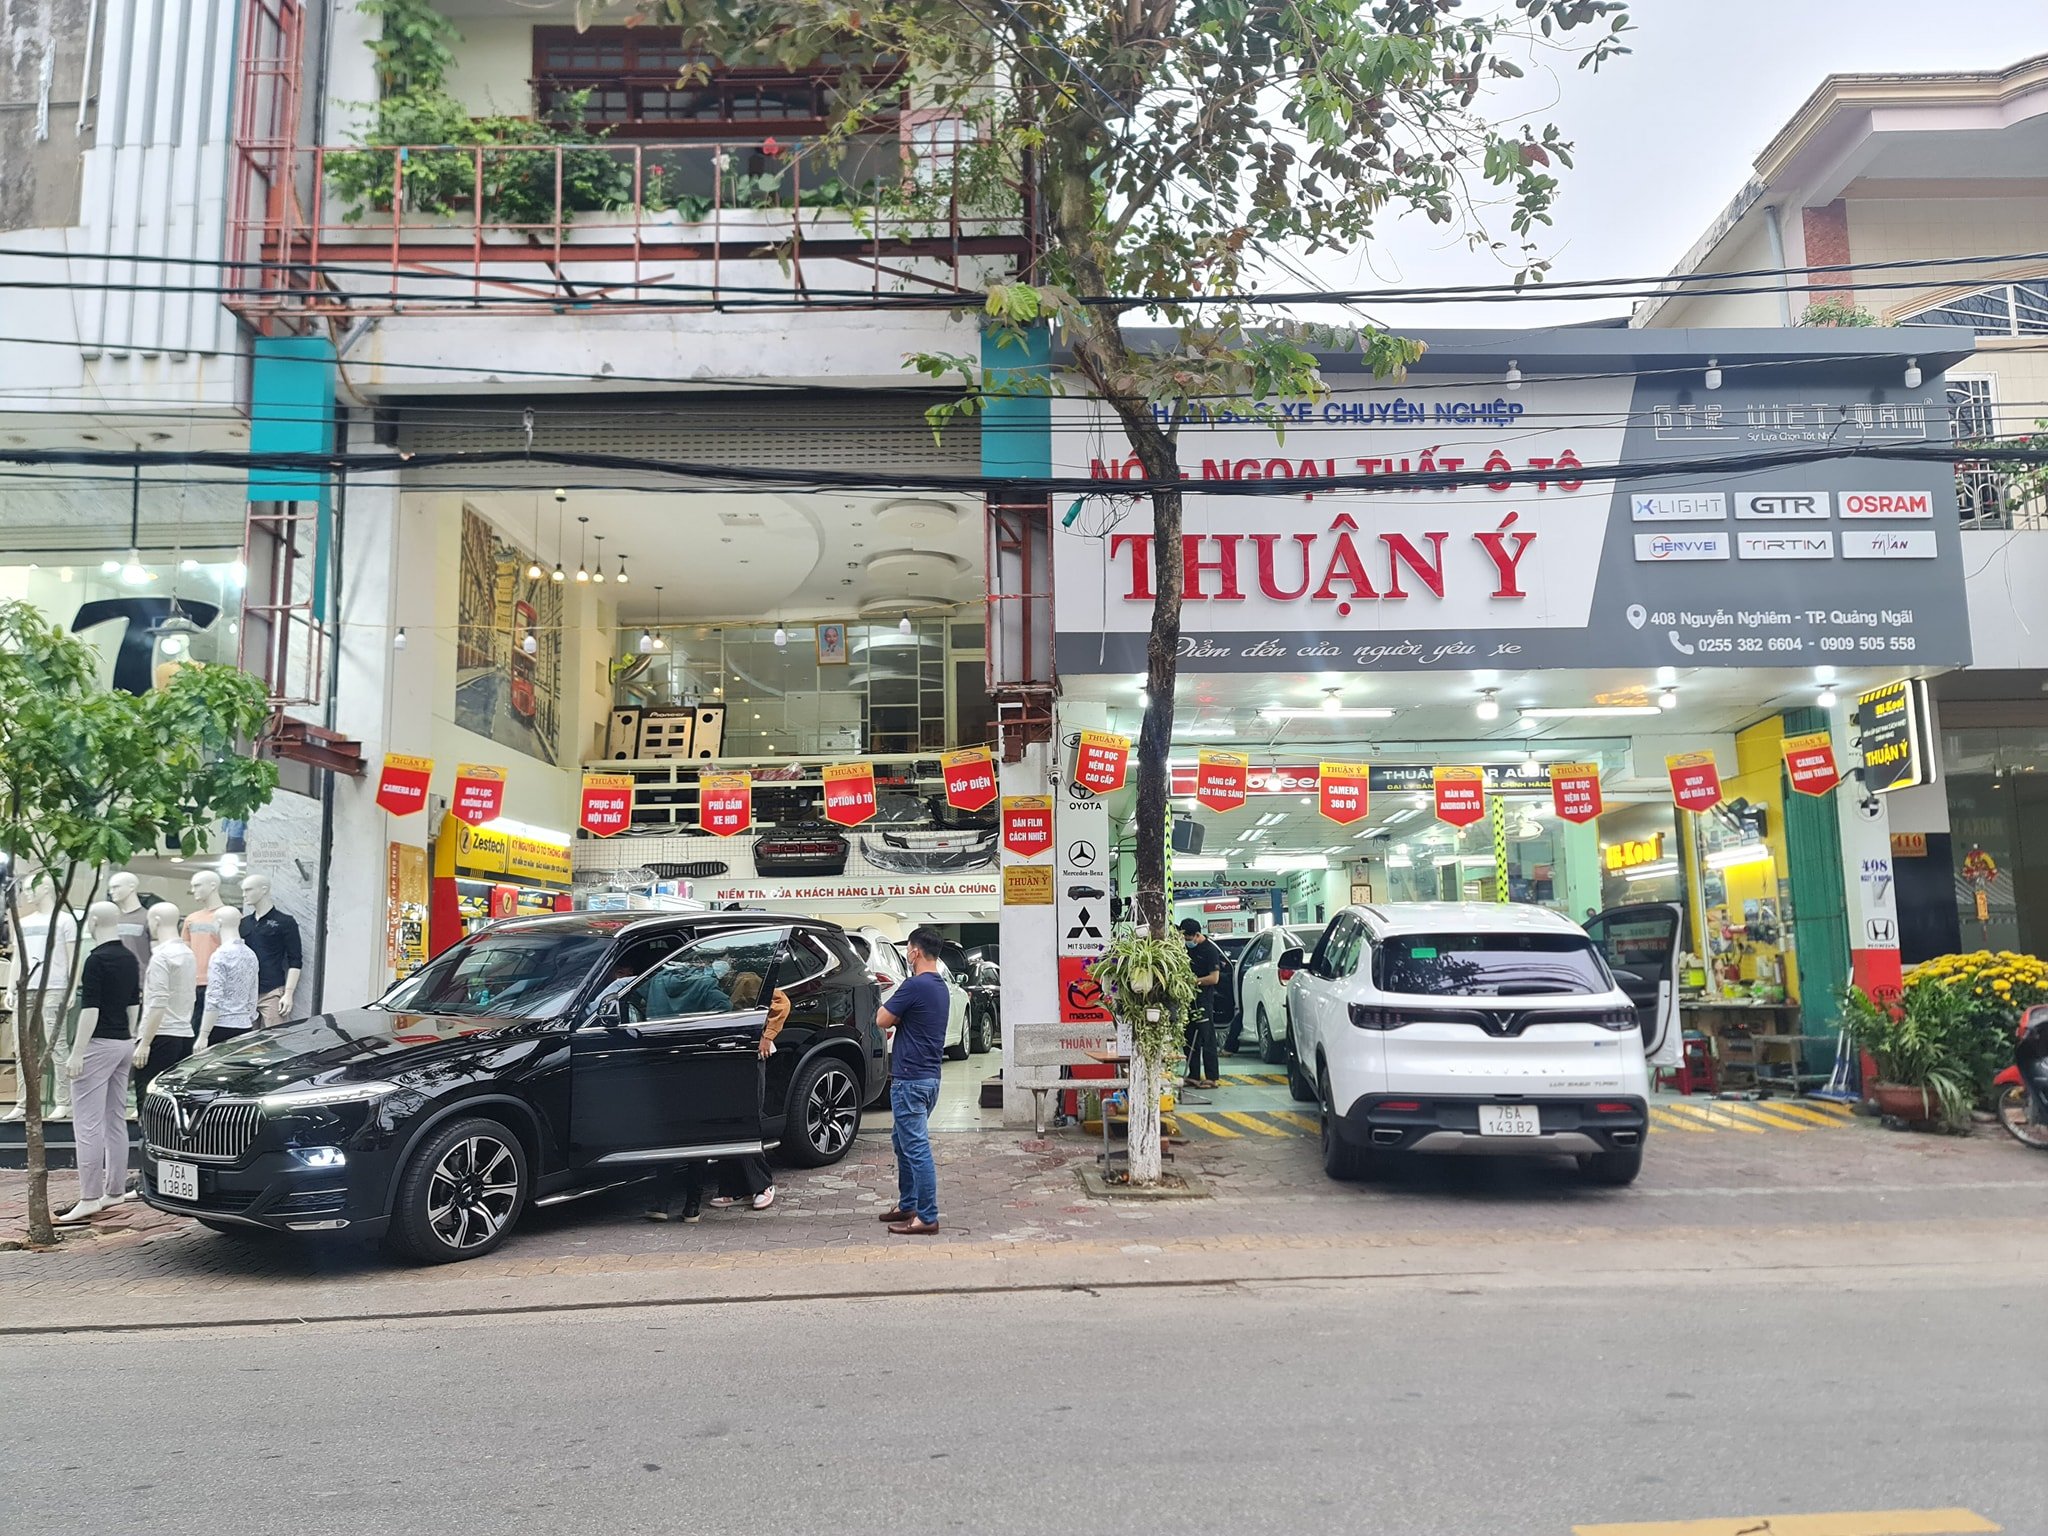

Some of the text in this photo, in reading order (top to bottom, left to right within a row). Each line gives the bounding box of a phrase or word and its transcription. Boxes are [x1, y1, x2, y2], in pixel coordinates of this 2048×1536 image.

[1281, 397, 1524, 428] XE CHUYÊN NGHIỆP
[1802, 431, 1815, 440] Tốt
[1528, 449, 1584, 492] TÔ
[1750, 496, 1817, 514] GTR
[1846, 495, 1928, 513] OSRAM
[1746, 539, 1827, 551] TIRTIM
[1110, 511, 1538, 618] THUẬN Ý
[1651, 608, 1913, 629] 408 Nguyễn Nghiêm TP. Quảng Ngãi
[1241, 638, 1288, 658] đến
[1297, 640, 1342, 657] của
[1353, 639, 1422, 664] người
[1419, 640, 1477, 664] yêu
[1487, 643, 1523, 658] xe
[1698, 637, 1916, 652] 0255 382 6604 0909 505 558
[1088, 748, 1119, 761] MAY BỌC
[1865, 738, 1908, 768] THUẬN Ý
[1088, 760, 1115, 773] NỆM DA
[950, 776, 991, 794] CỐP ĐIỆN
[1085, 772, 1115, 785] CAO CẤP
[1207, 776, 1224, 786] NÂNG
[1224, 776, 1238, 787] CẤP
[1328, 785, 1360, 796] CAMERA
[1576, 781, 1591, 790] BỌC
[1706, 786, 1716, 796] XE
[828, 791, 873, 808] OPTION Ô TÔ
[1199, 787, 1244, 799] ĐÈN TĂNG SÁNG
[589, 799, 609, 811] PHỤC
[708, 799, 725, 811] PHỦ
[1330, 798, 1357, 811] 360 ĐỘ
[1472, 800, 1481, 810] TÔ
[1564, 803, 1593, 815] CAO CẤP
[475, 810, 483, 820] TÔ
[588, 812, 622, 825] NỘI THẤT
[713, 814, 738, 826] XE HƠI
[1012, 816, 1043, 828] DÁN FILM
[1008, 830, 1048, 843] CÁCH NHIỆT
[473, 833, 505, 854] Zestech
[1861, 859, 1888, 873] 408
[1062, 869, 1104, 877] Mercedes-Benz
[748, 889, 766, 899] TIN
[796, 886, 835, 899] KHÁCH
[838, 884, 868, 898] HÀNG
[871, 884, 885, 897] LÀ
[888, 883, 905, 896] TÀI
[908, 882, 931, 895] SẢN
[934, 881, 955, 895] CỦA
[959, 882, 997, 894] CHÚNG
[1060, 1035, 1102, 1051] THUẬN Ý
[1496, 1107, 1523, 1120] 76A
[1488, 1120, 1534, 1134] 143.82
[169, 1164, 187, 1181] 76A
